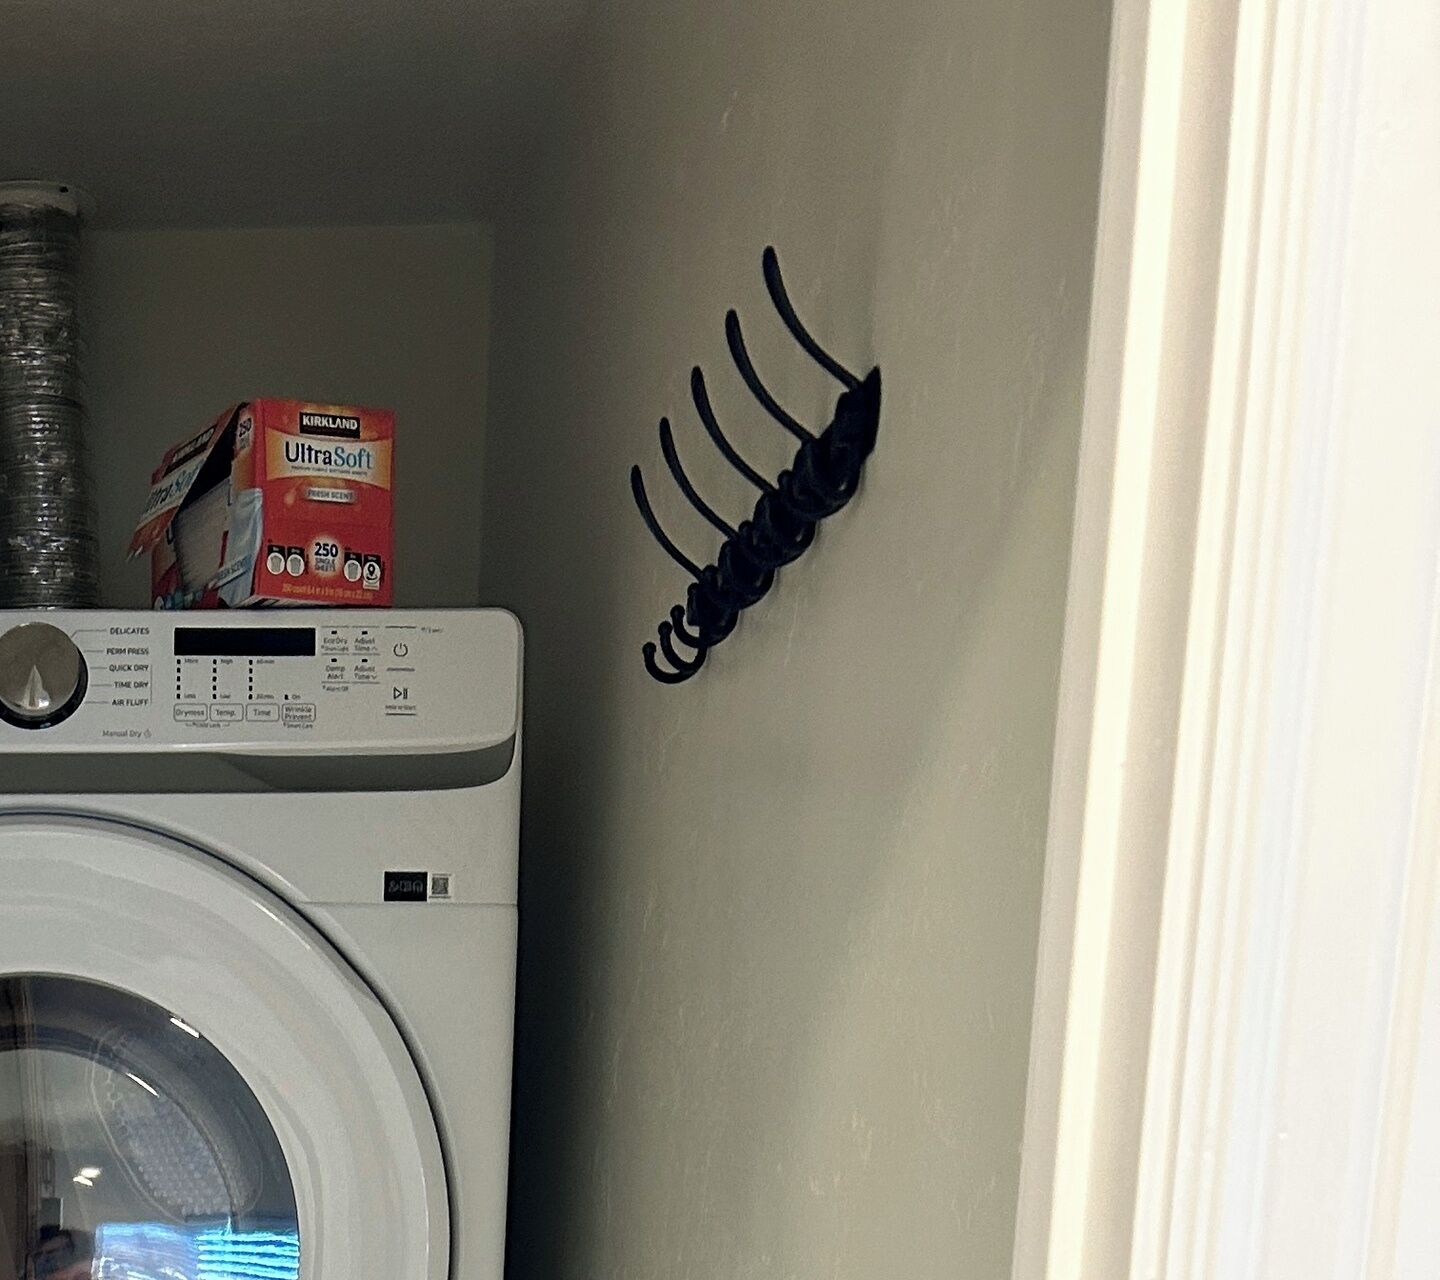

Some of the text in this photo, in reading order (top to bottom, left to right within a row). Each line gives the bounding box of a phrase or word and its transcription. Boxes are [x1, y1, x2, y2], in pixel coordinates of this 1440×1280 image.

[302, 414, 358, 431] KIRKLAND
[285, 441, 373, 469] UltraSoft
[331, 491, 353, 501] SCENT
[314, 541, 339, 558] 250
[109, 627, 150, 635] DELICATES
[106, 647, 149, 655] PERM PRESS
[109, 664, 149, 672] QUICK DRY
[114, 681, 149, 689] TIME DRY
[111, 699, 149, 707] AIR FLUFF
[254, 708, 271, 716] Time
[102, 729, 142, 739] Manual Dry
